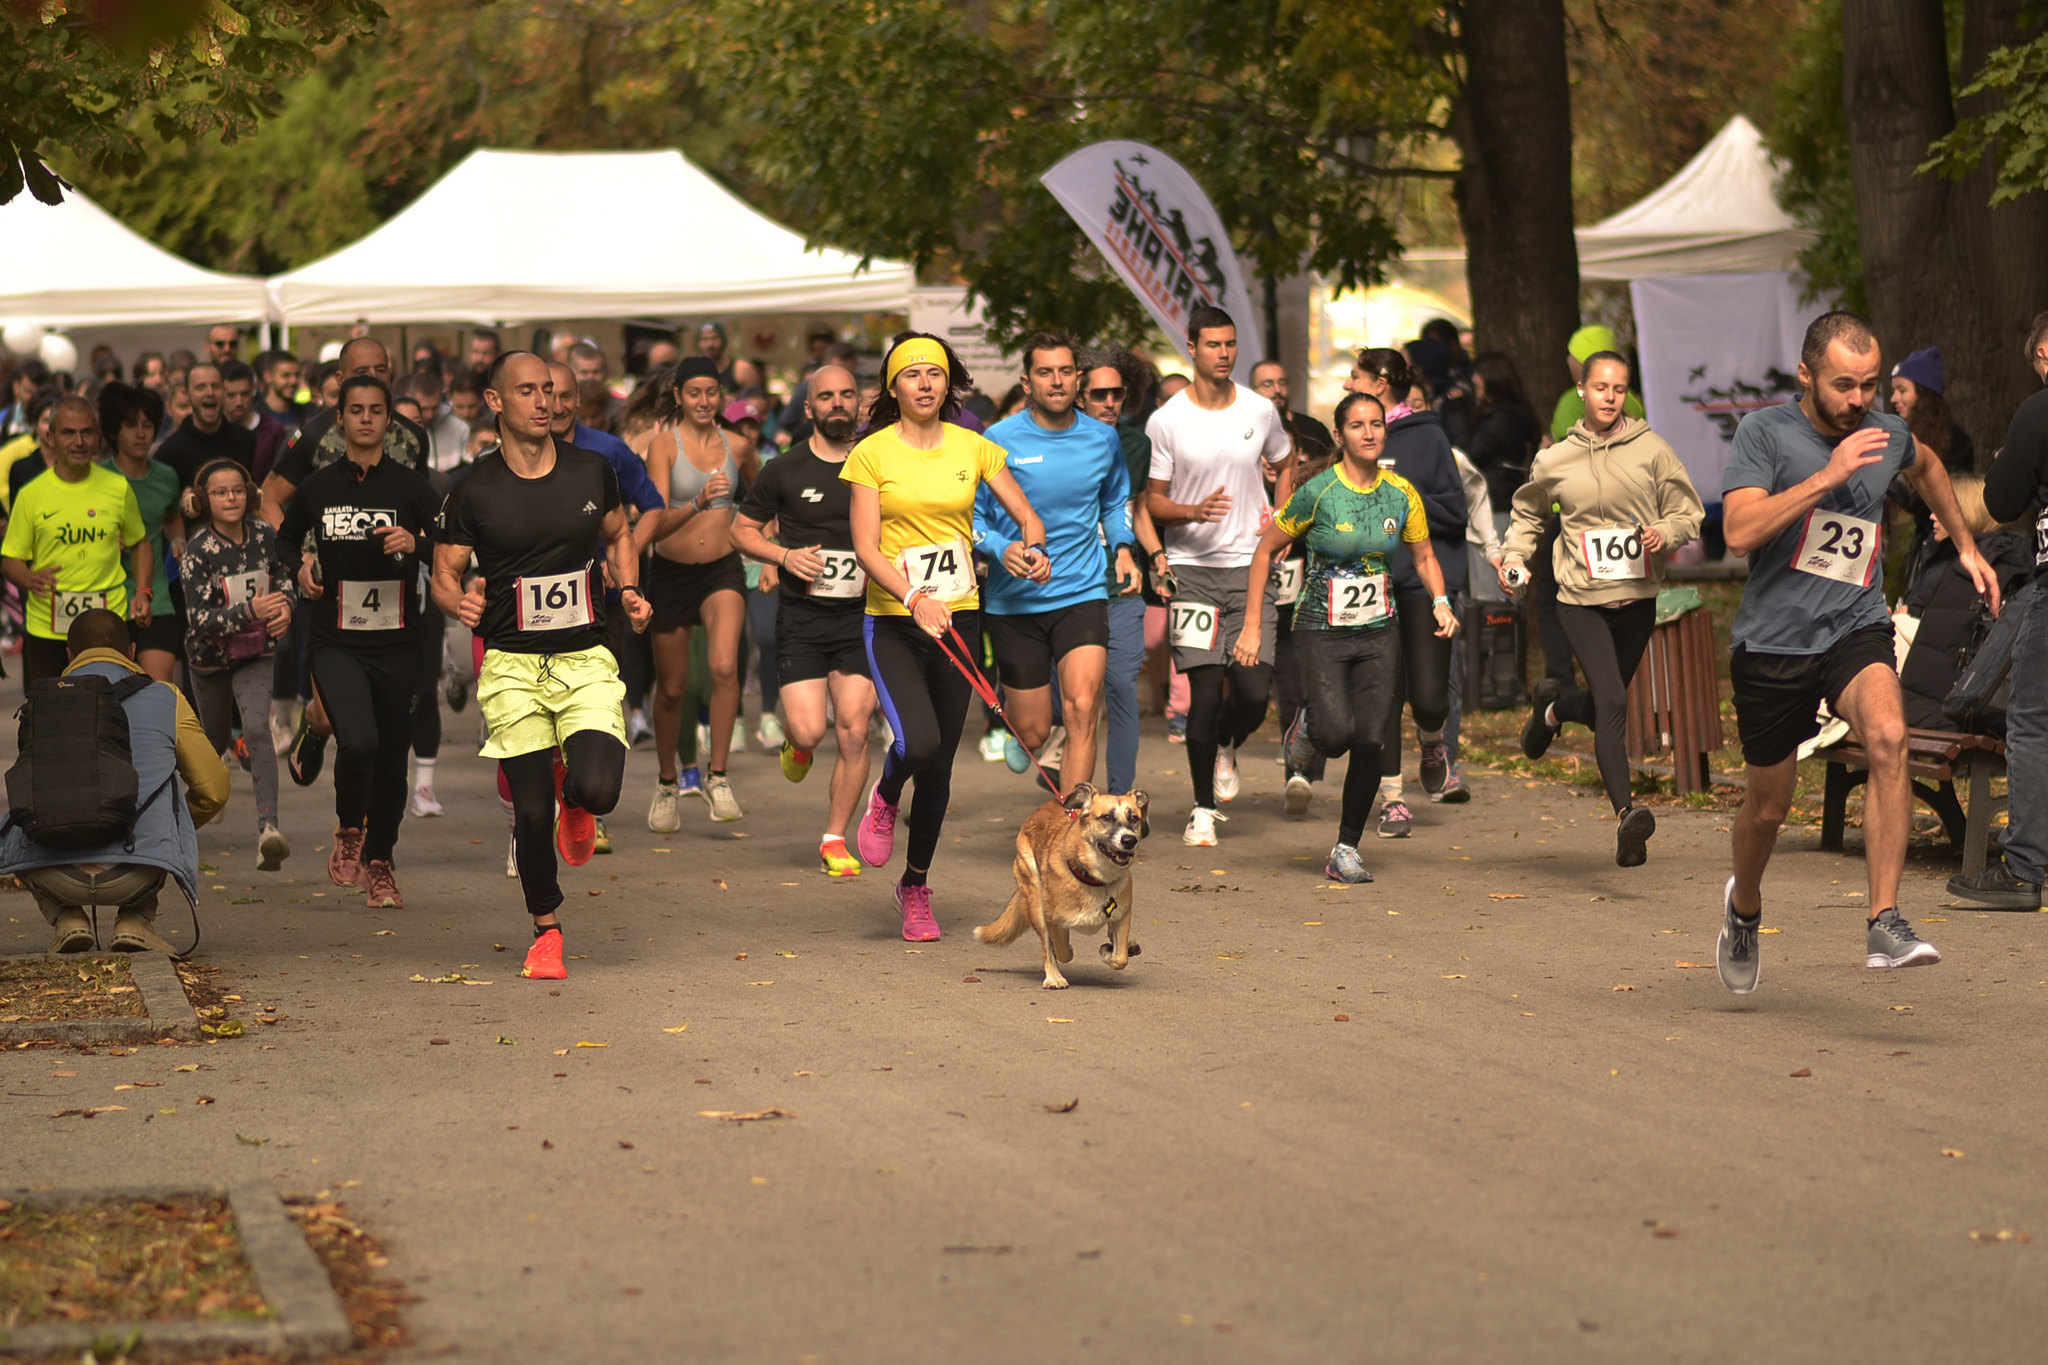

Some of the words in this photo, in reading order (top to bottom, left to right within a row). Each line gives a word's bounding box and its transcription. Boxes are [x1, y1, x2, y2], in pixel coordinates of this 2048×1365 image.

[1591, 535, 1643, 562] 160
[1817, 520, 1864, 560] 23
[821, 557, 857, 581] 52
[920, 549, 958, 581] 74
[246, 578, 257, 602] 5
[361, 588, 381, 613] 4
[530, 579, 578, 611] 161
[1343, 582, 1377, 609] 22
[1171, 607, 1212, 632] 170
